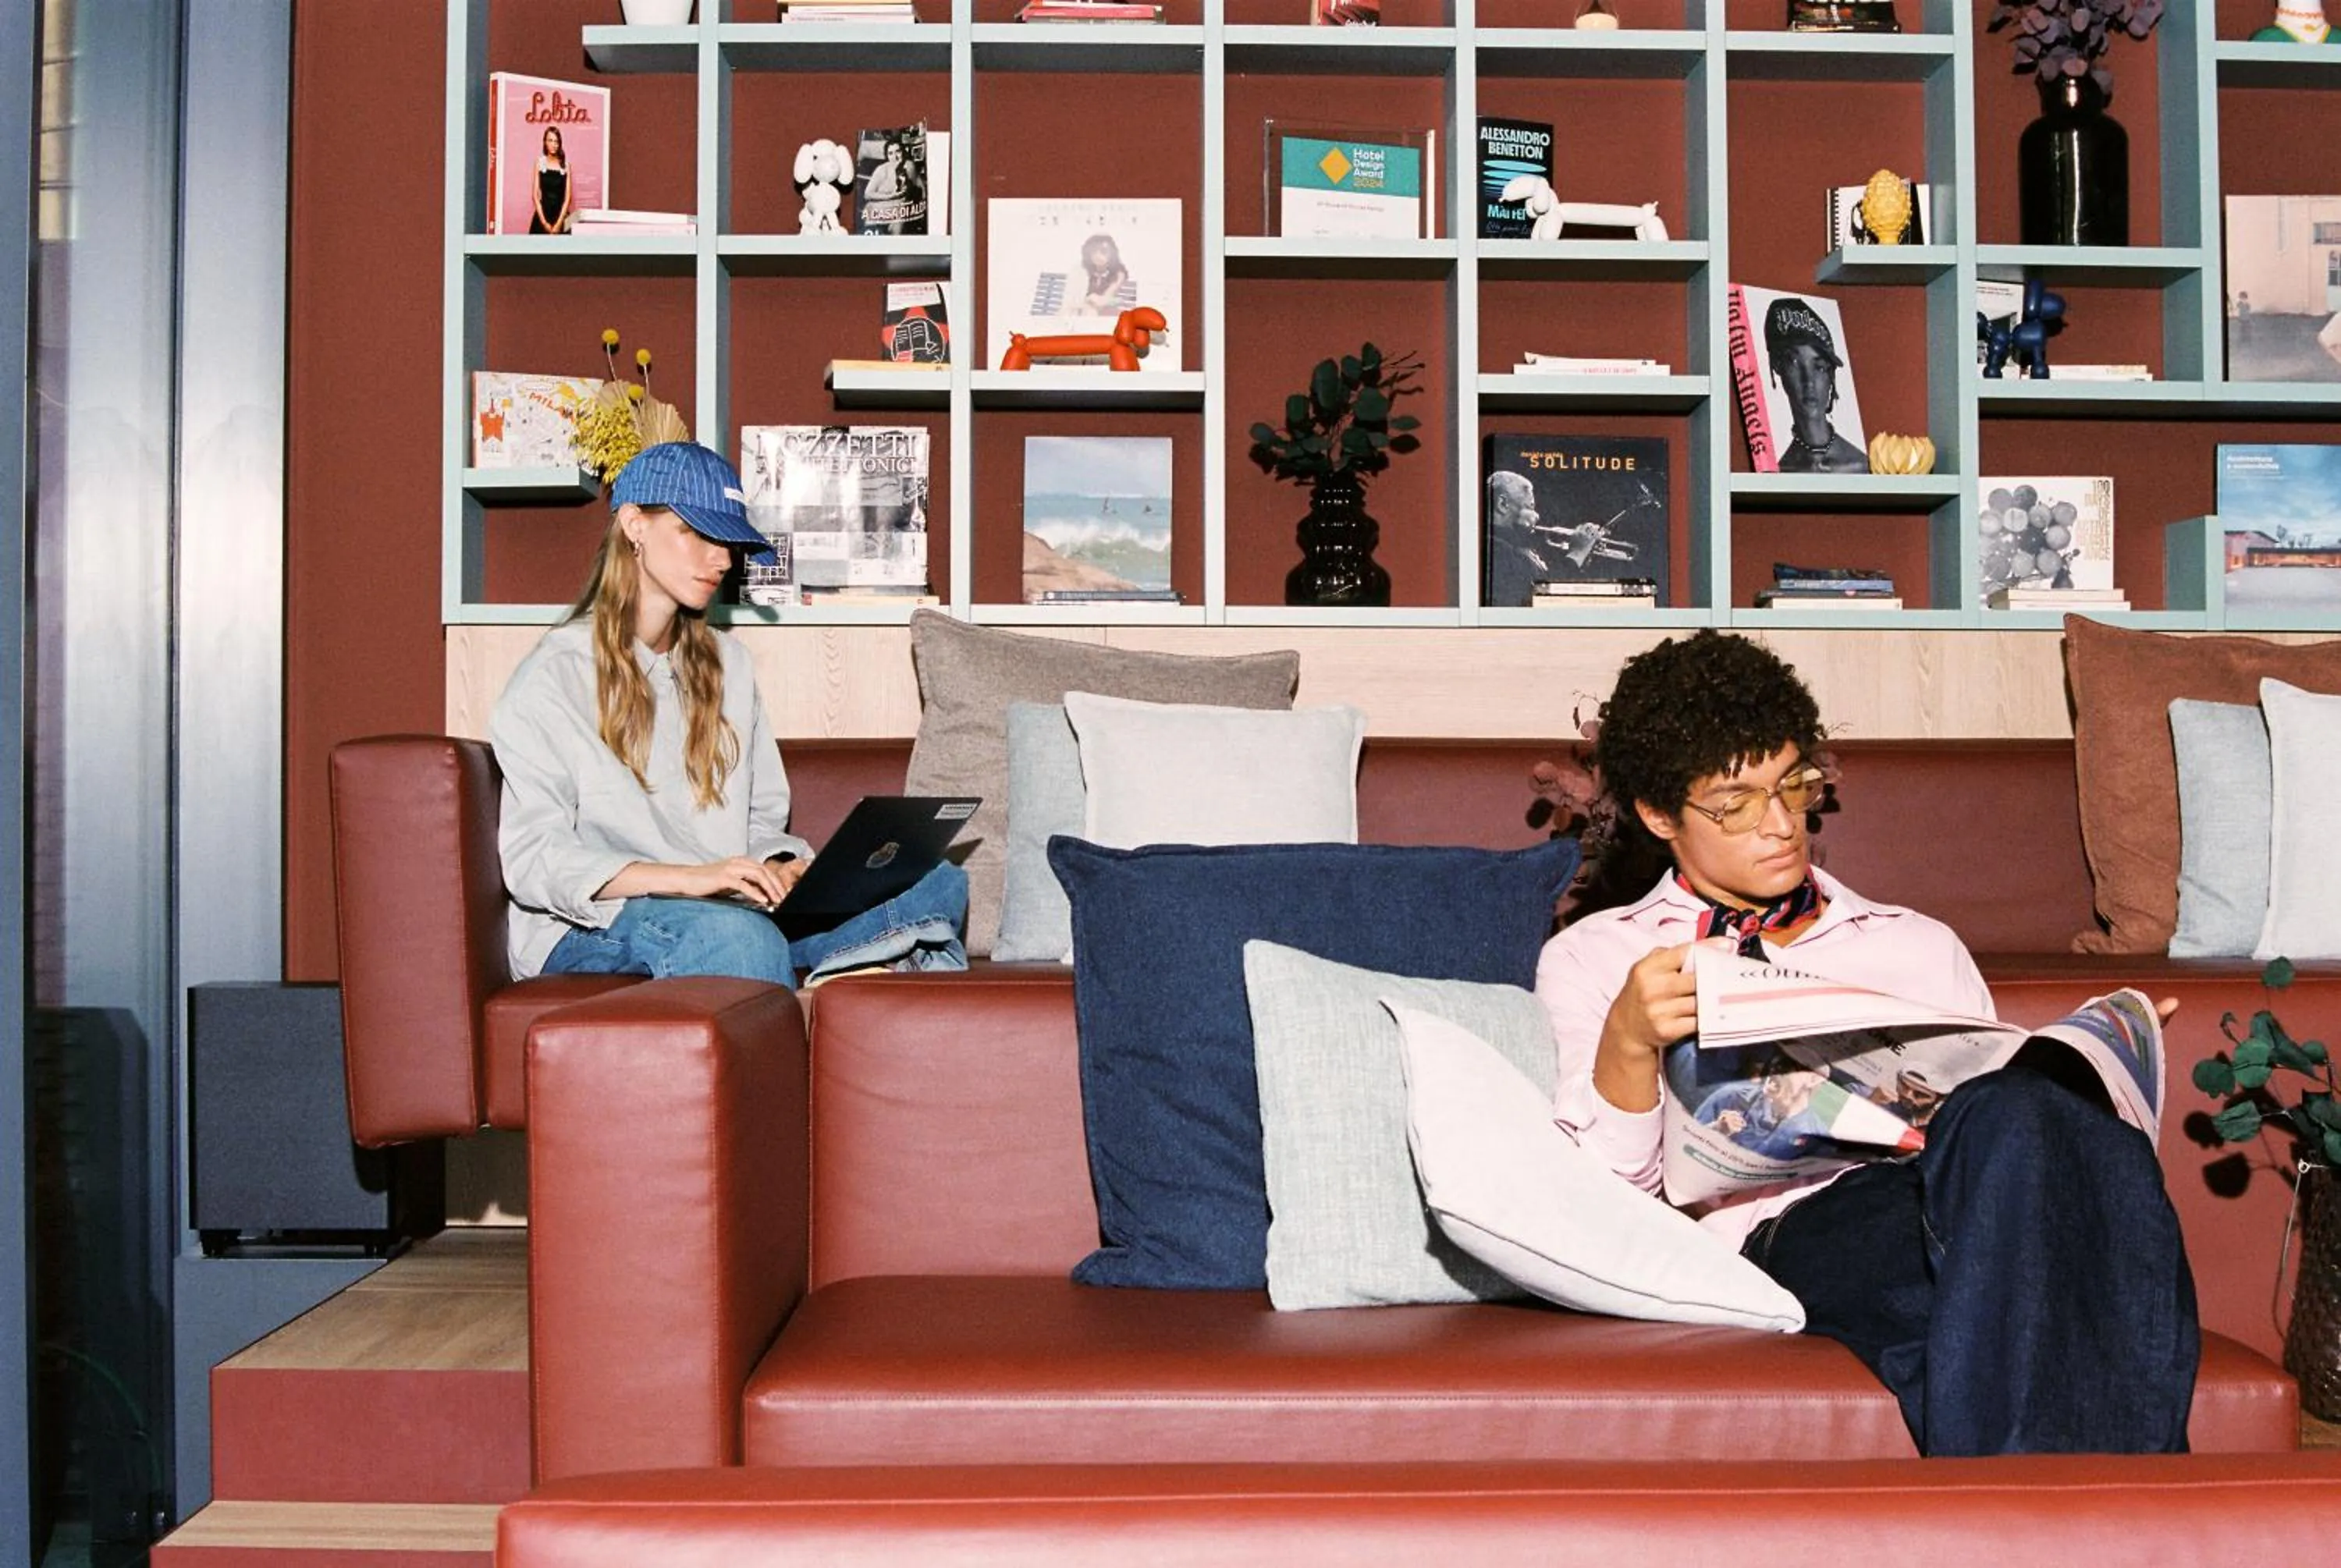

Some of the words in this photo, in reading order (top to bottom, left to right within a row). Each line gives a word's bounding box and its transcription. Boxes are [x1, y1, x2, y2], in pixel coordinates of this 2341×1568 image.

[525, 90, 592, 123] Lolita
[1480, 126, 1551, 146] ALESSANDRO
[1353, 148, 1385, 161] Hotel
[1488, 142, 1544, 159] BENETTON
[1353, 168, 1384, 179] Award
[1530, 455, 1636, 470] SOLITUDE
